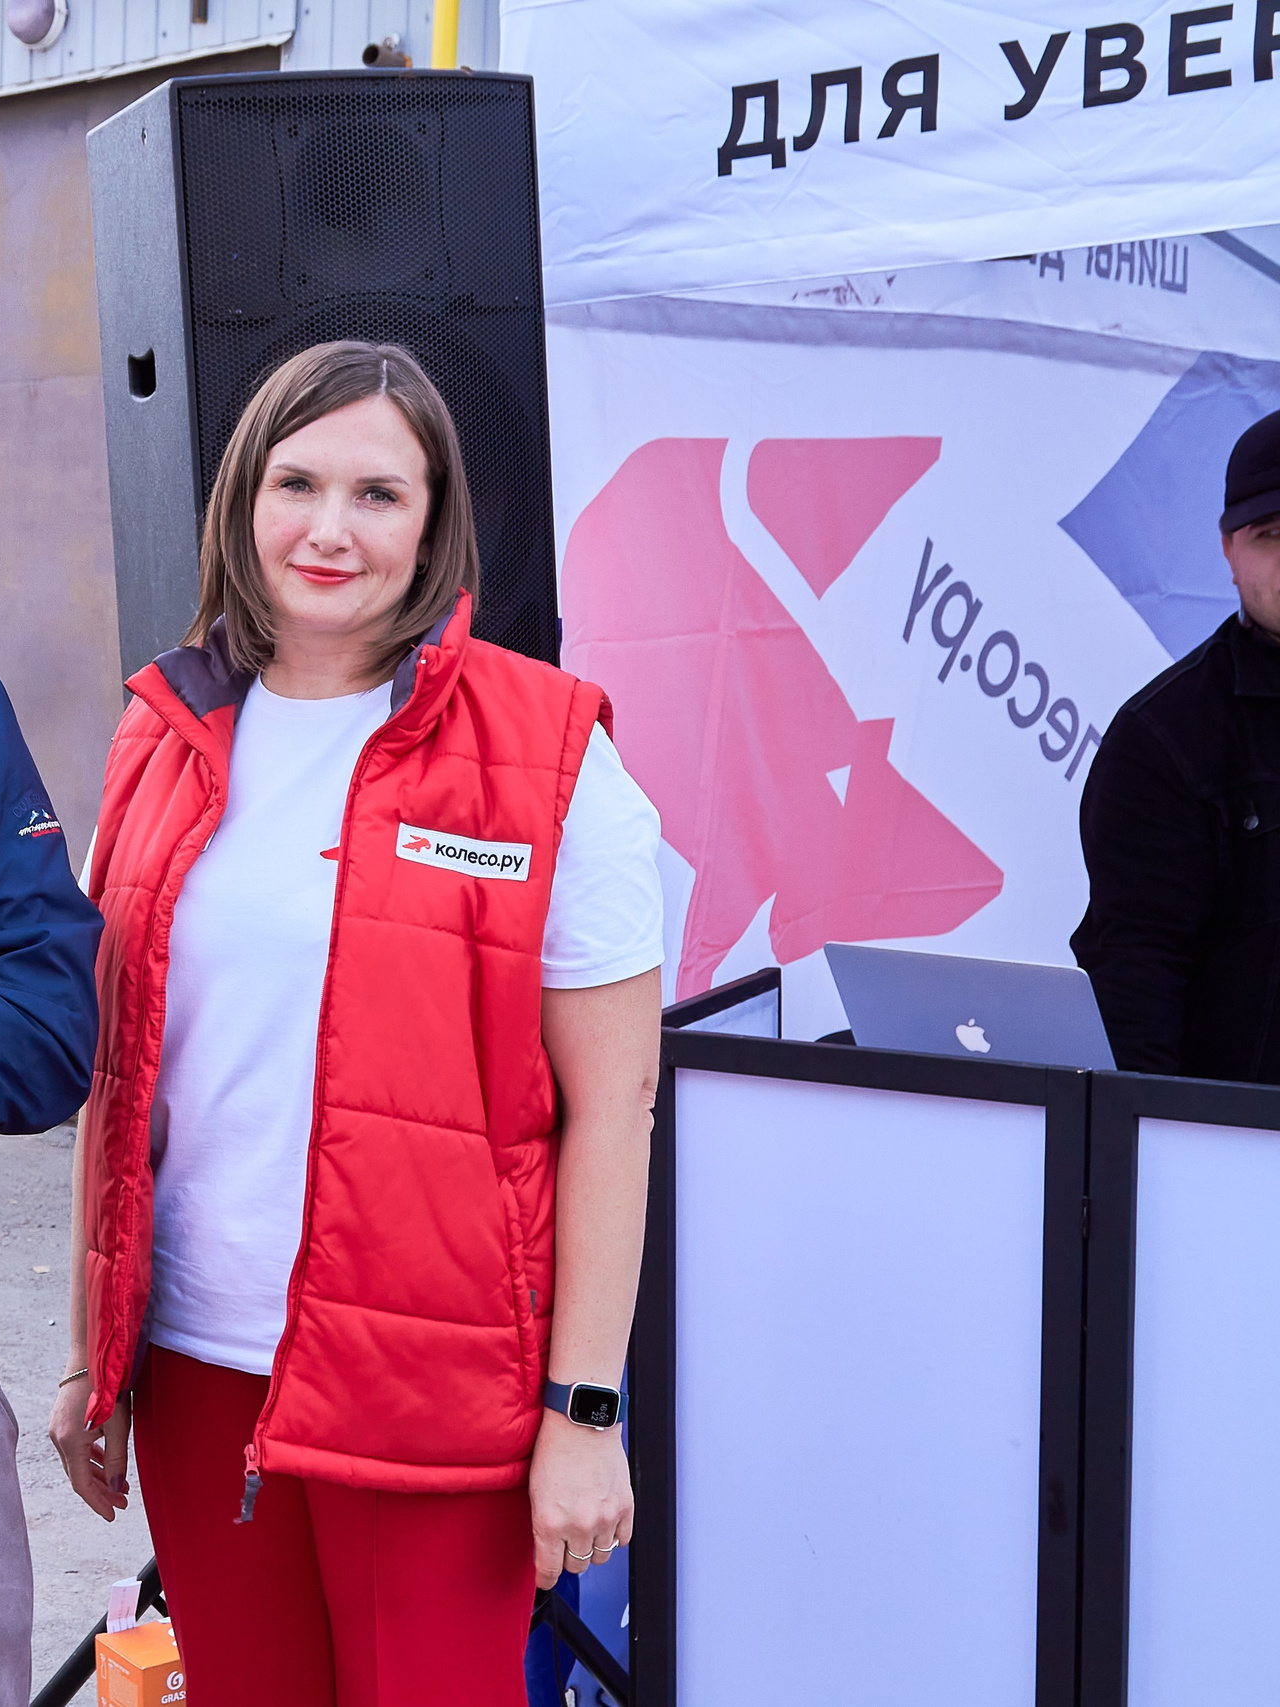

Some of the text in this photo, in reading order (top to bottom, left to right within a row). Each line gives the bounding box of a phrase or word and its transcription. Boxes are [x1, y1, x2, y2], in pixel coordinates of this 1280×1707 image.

[718, 53, 939, 177] ДЛЯ
[435, 843, 524, 872] колесо.ру
[161, 1690, 186, 1704] GRAS
